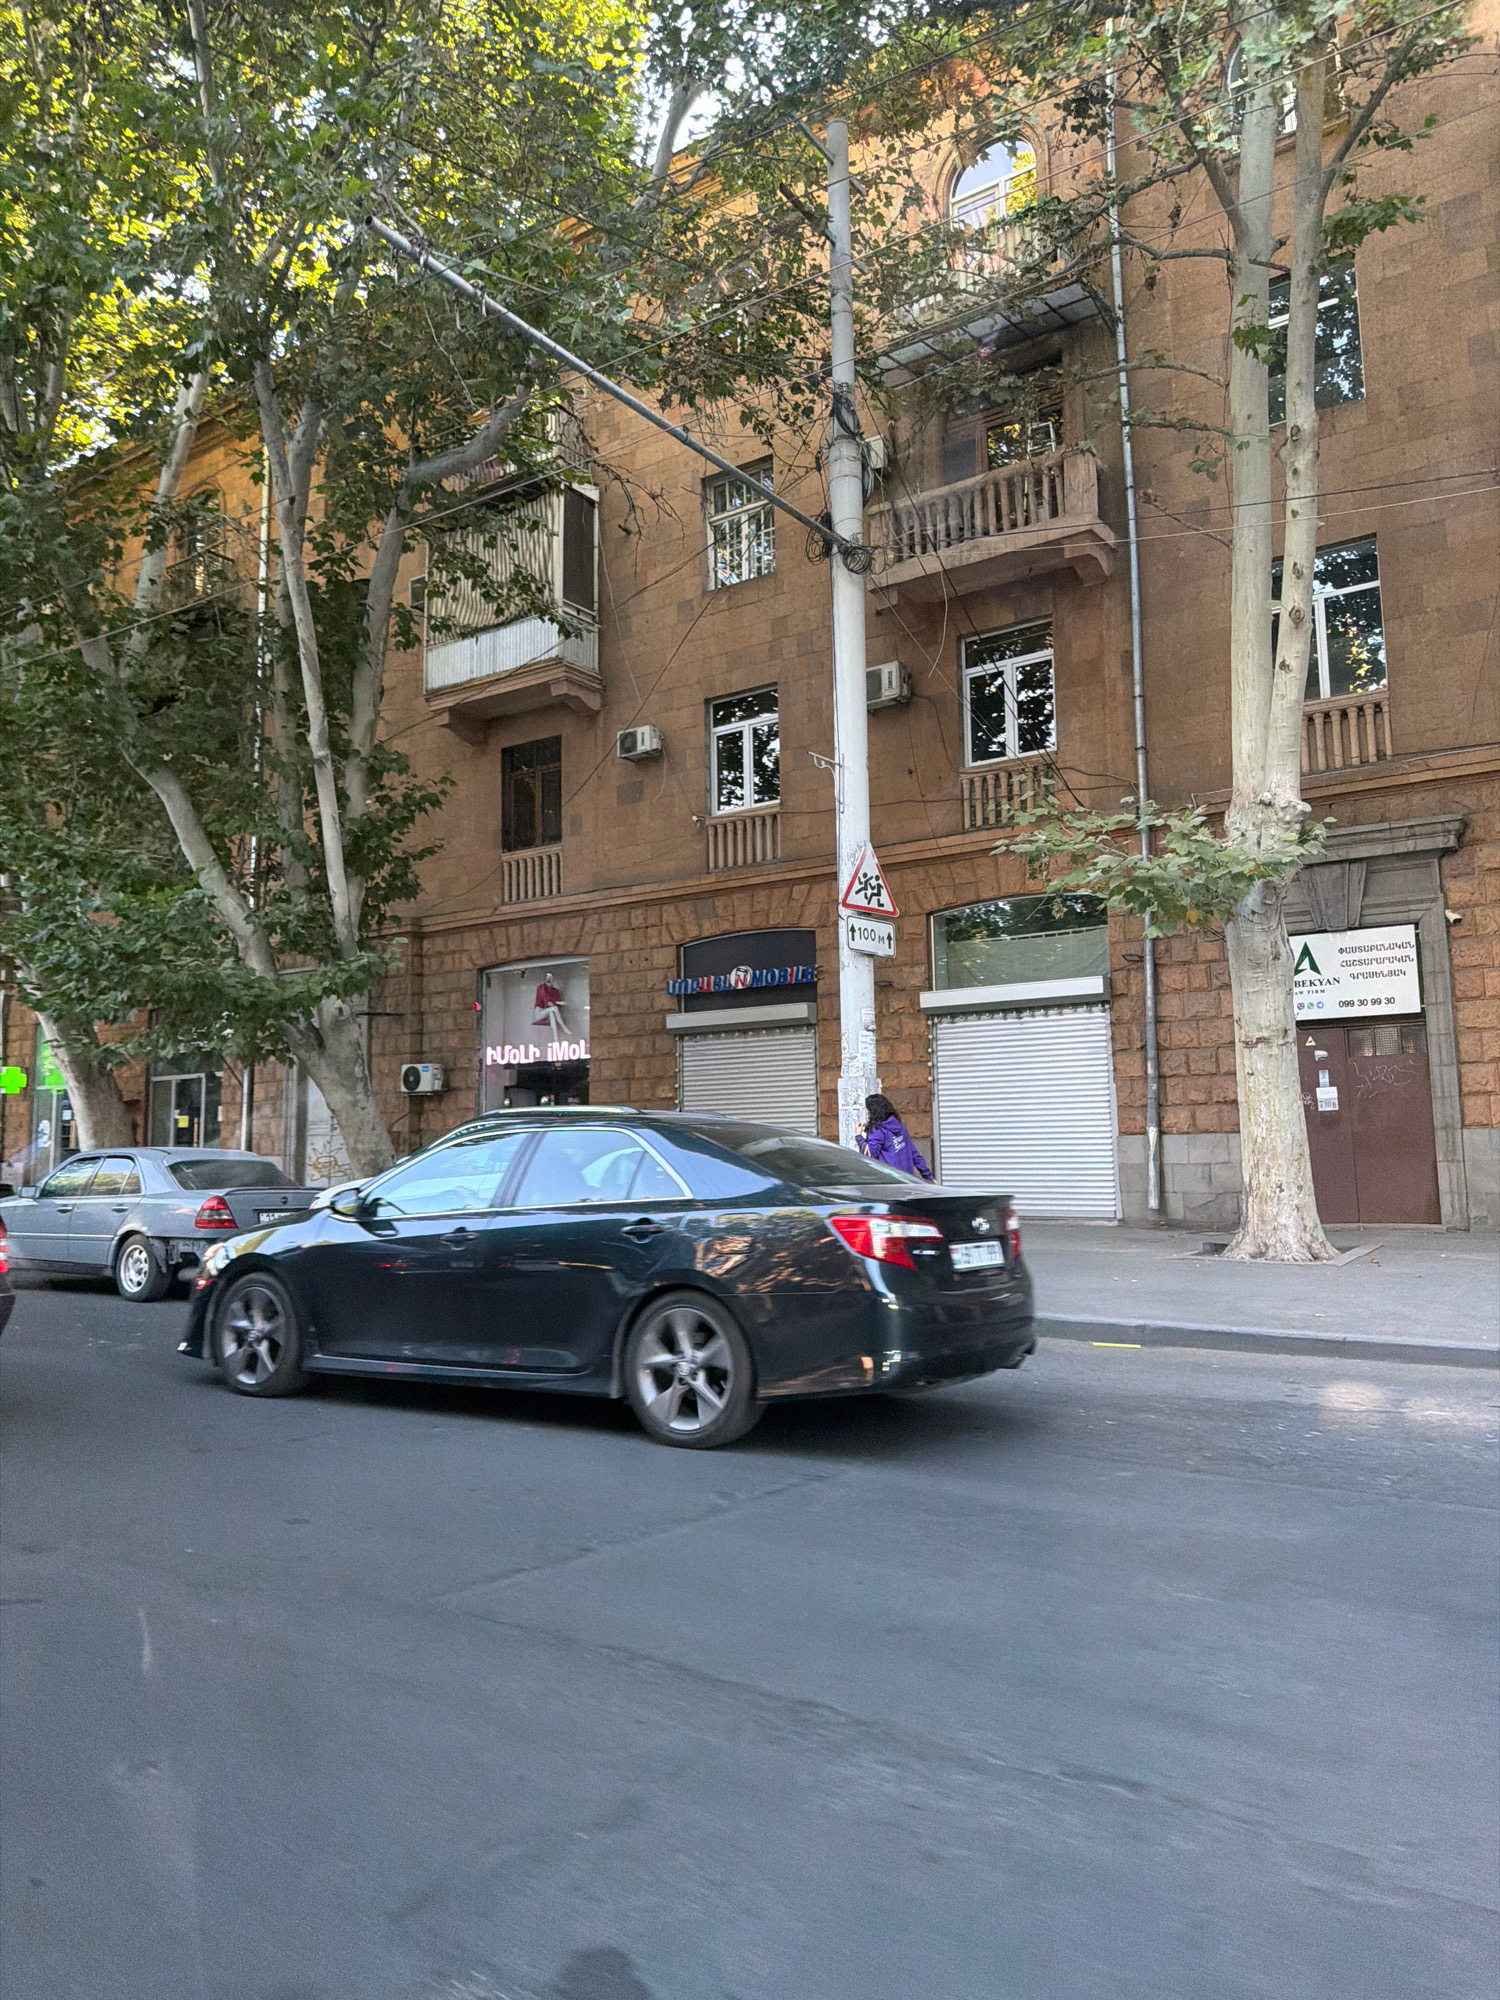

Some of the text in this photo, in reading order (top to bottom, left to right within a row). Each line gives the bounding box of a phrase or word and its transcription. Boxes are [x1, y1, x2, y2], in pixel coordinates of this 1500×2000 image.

[857, 926, 876, 941] 100
[1337, 941, 1415, 955] ՓԱՍՏԱԲԱՆԱԿԱՆ
[1340, 954, 1414, 968] ՀԱՇՏԱՐԱՐԱԿԱՆ
[751, 964, 816, 988] MOBILE
[1349, 968, 1406, 980] ԳՐԱՍԵՆՅԱԿ
[1294, 977, 1340, 988] BEKYAN
[1338, 996, 1395, 1008] 099 30 99 30
[547, 1039, 591, 1062] iMoL
